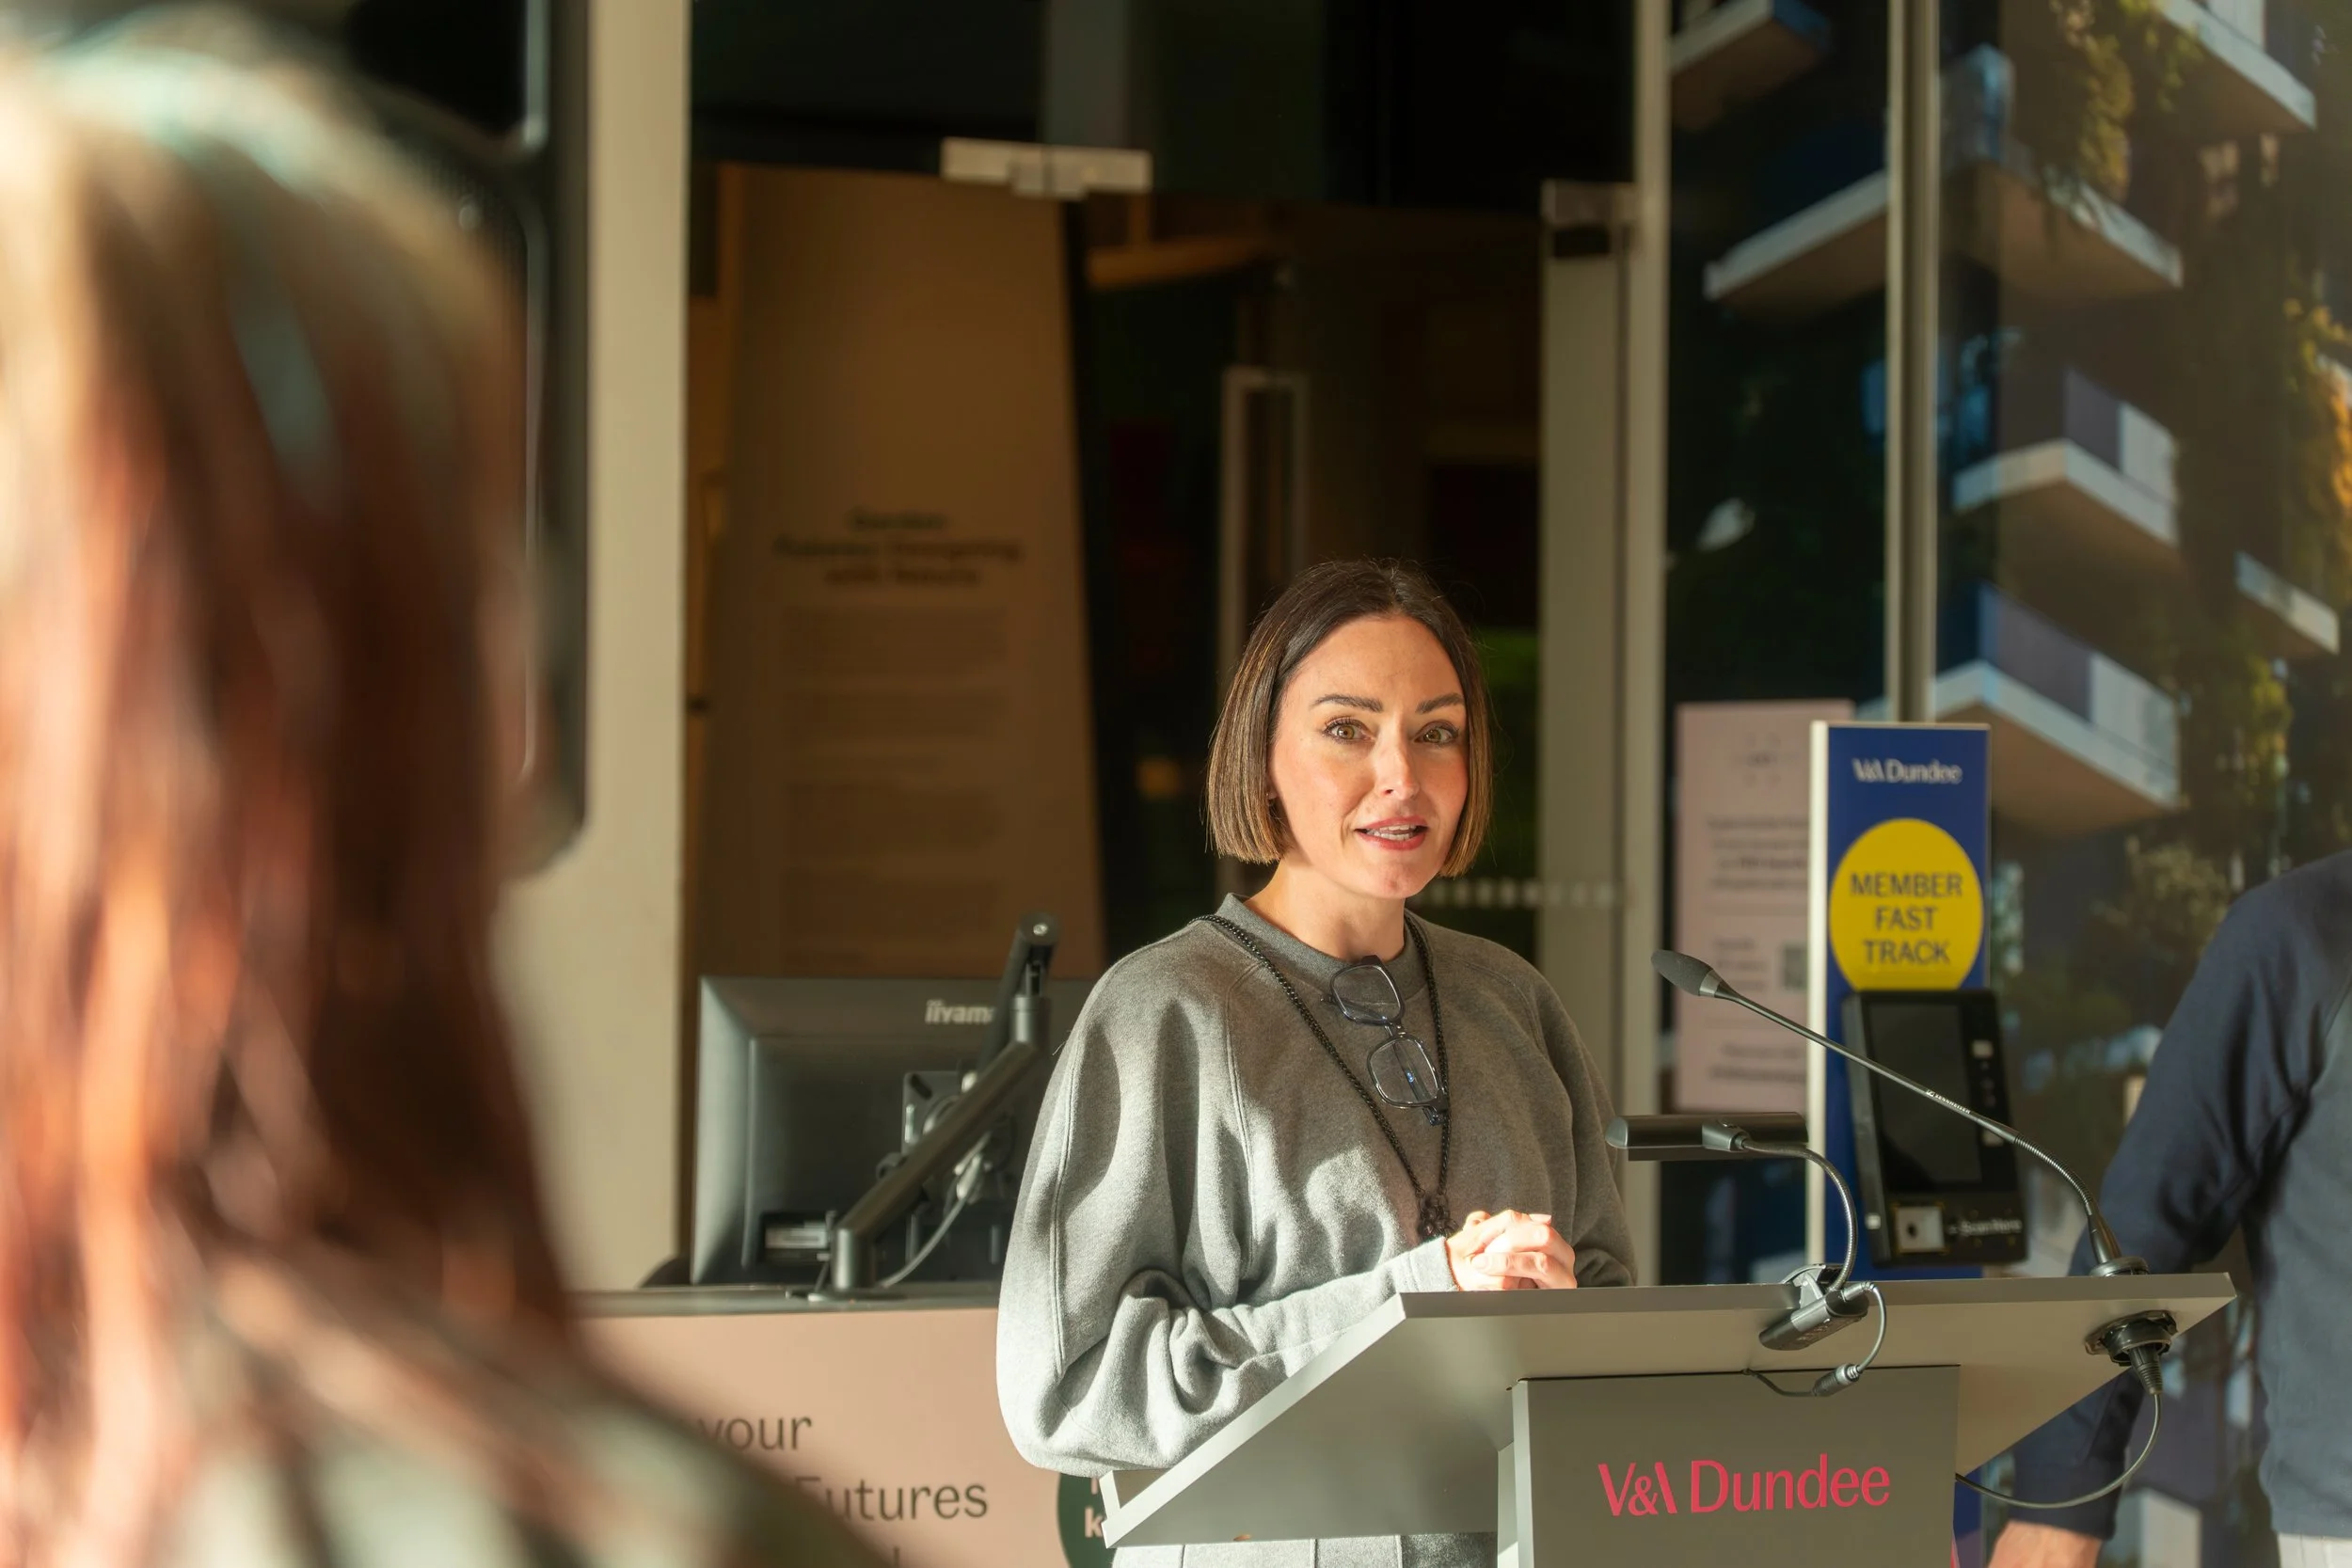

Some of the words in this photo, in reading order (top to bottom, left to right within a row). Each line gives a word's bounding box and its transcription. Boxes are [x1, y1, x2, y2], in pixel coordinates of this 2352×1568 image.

[1885, 758, 1963, 784] Dundee
[1850, 872, 1963, 898] MEMBER
[1874, 905, 1938, 931] FAST
[1863, 939, 1950, 965] TRACK
[925, 999, 995, 1023] iiyam
[1934, 1092, 1971, 1115] SENNHEISER
[1598, 1461, 1677, 1516] V&A
[1691, 1453, 1890, 1513] Dundee
[795, 1476, 988, 1522] utures
